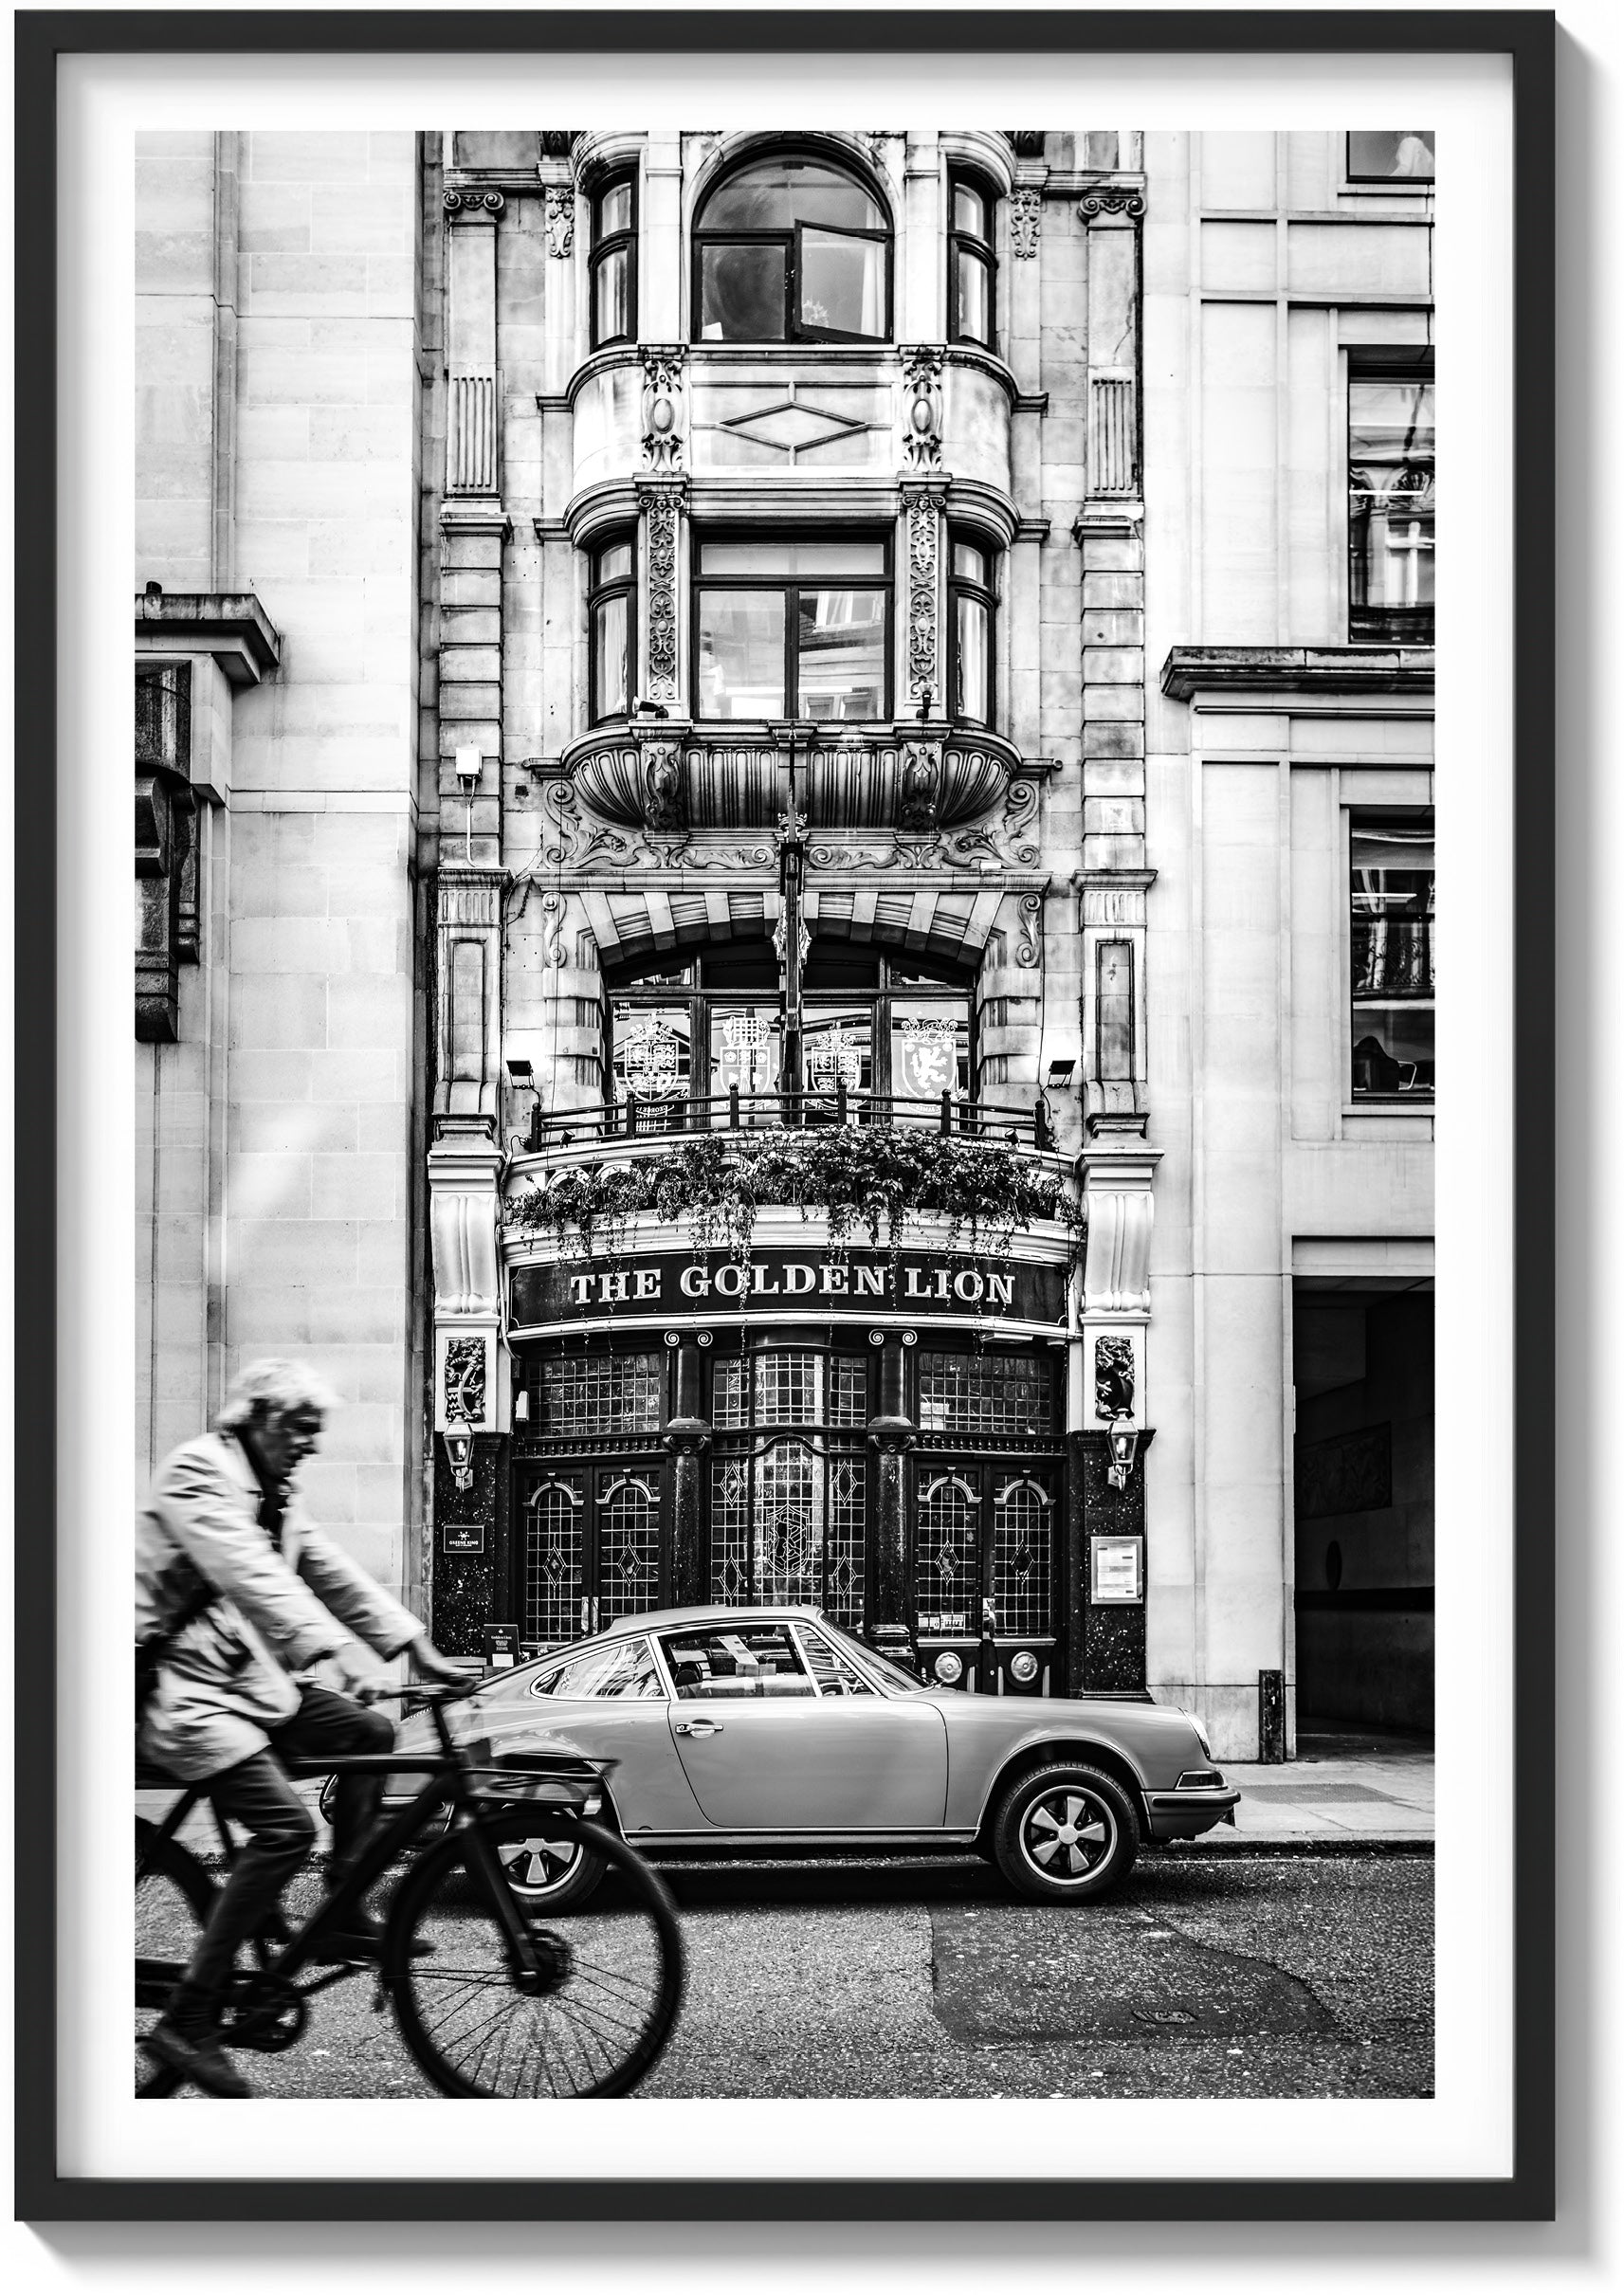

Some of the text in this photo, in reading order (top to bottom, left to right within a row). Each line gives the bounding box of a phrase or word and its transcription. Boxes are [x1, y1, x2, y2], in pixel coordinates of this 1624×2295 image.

[571, 1265, 1015, 1304] THE GOLDEN LION
[1270, 1695, 1276, 1705] 1
